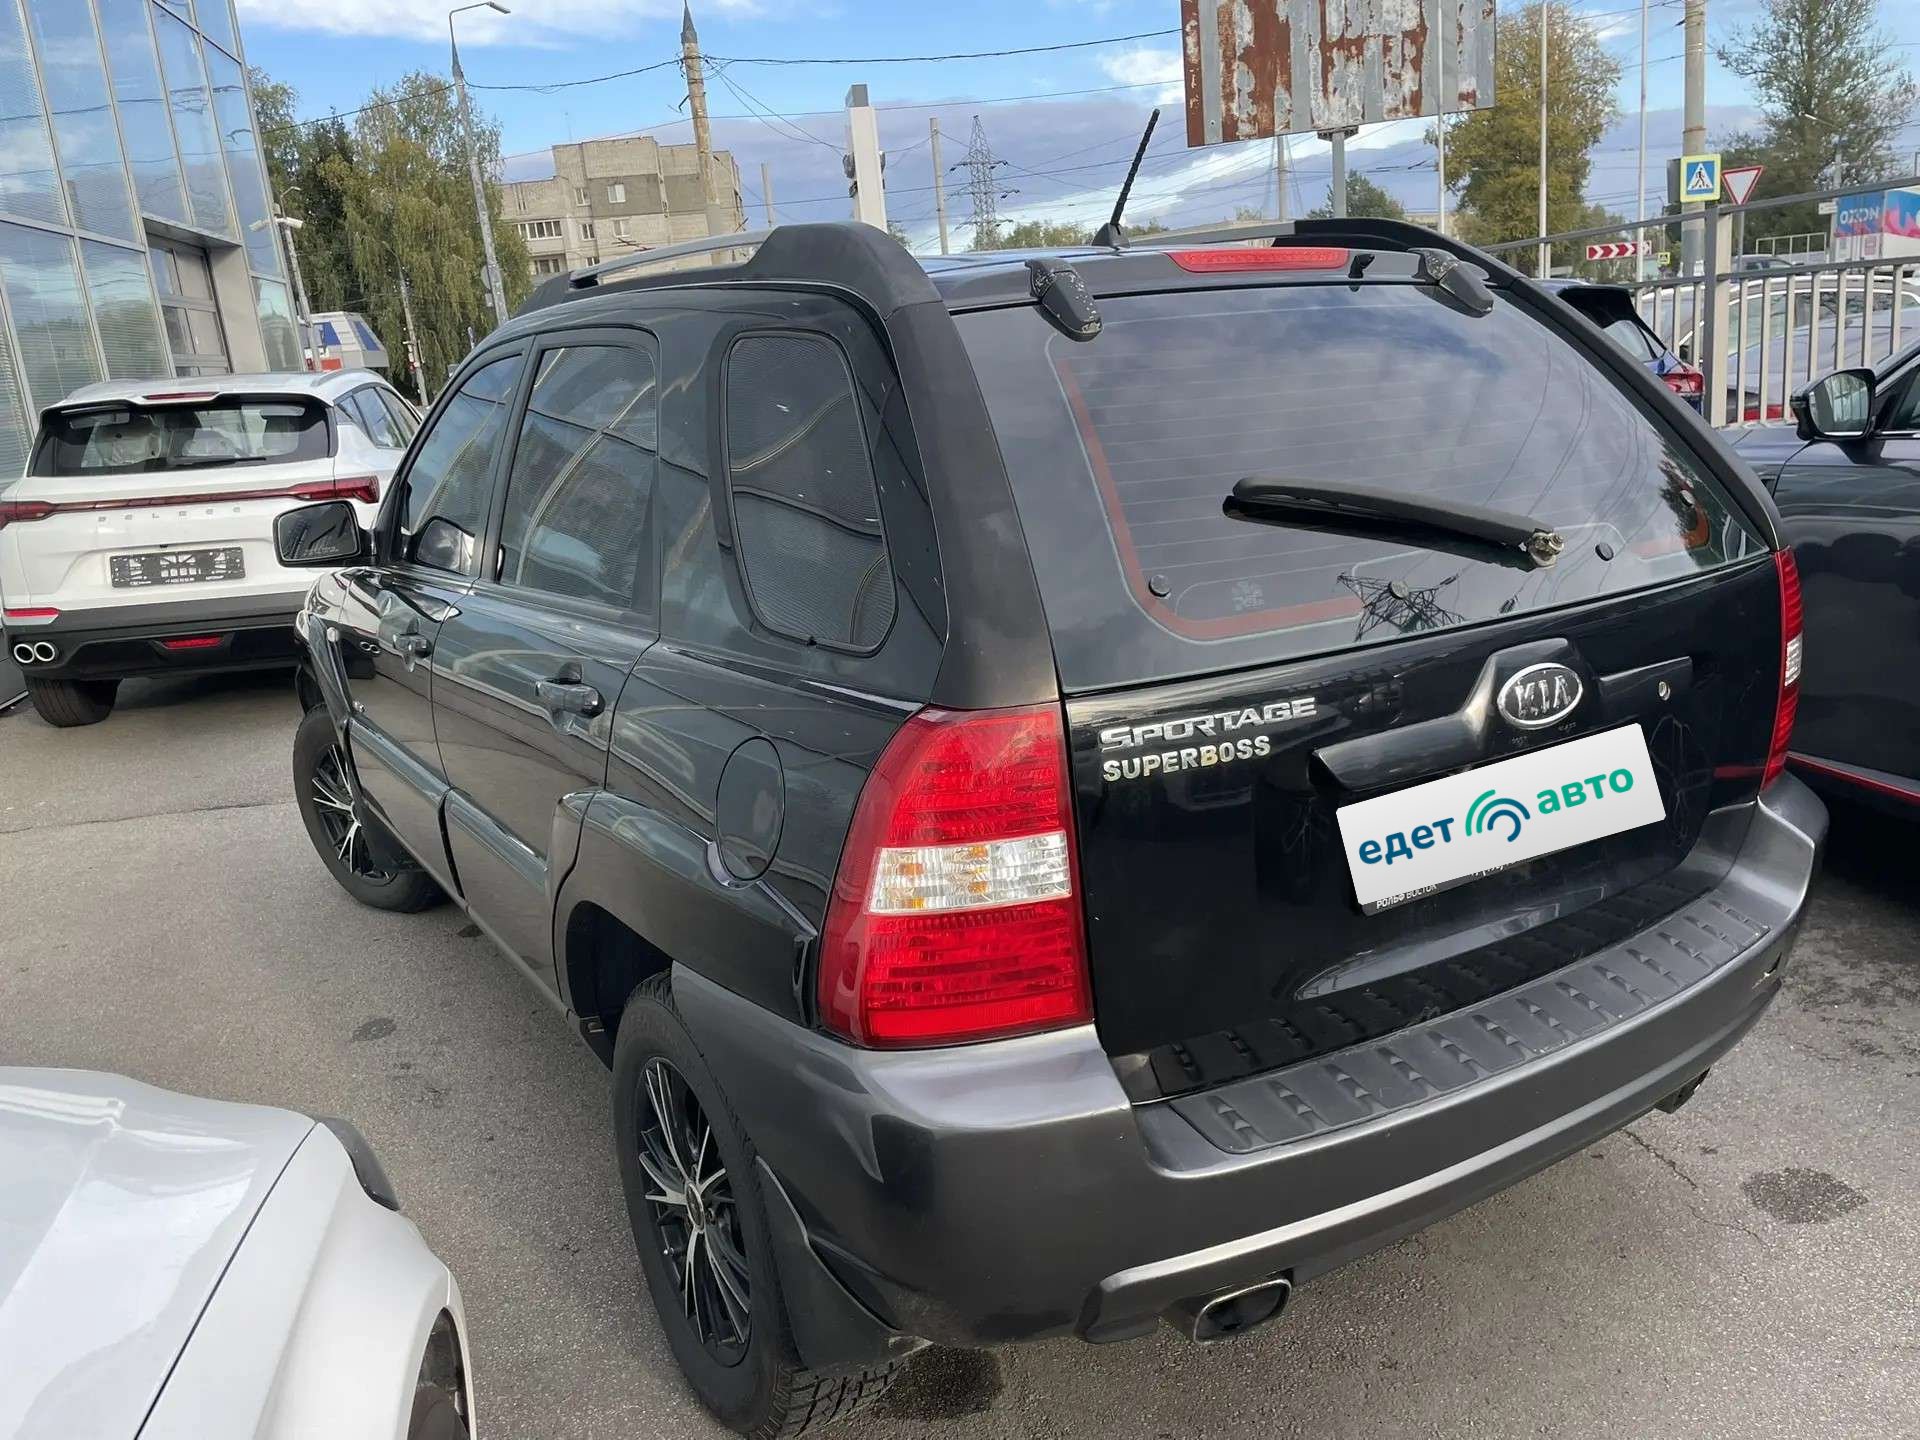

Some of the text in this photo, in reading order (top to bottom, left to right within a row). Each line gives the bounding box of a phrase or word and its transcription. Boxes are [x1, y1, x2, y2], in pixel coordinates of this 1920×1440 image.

[1839, 206, 1880, 225] OZON
[1514, 675, 1571, 718] KIA
[1100, 697, 1317, 752] SPORTAGE
[1103, 735, 1271, 782] SUPERBOSS
